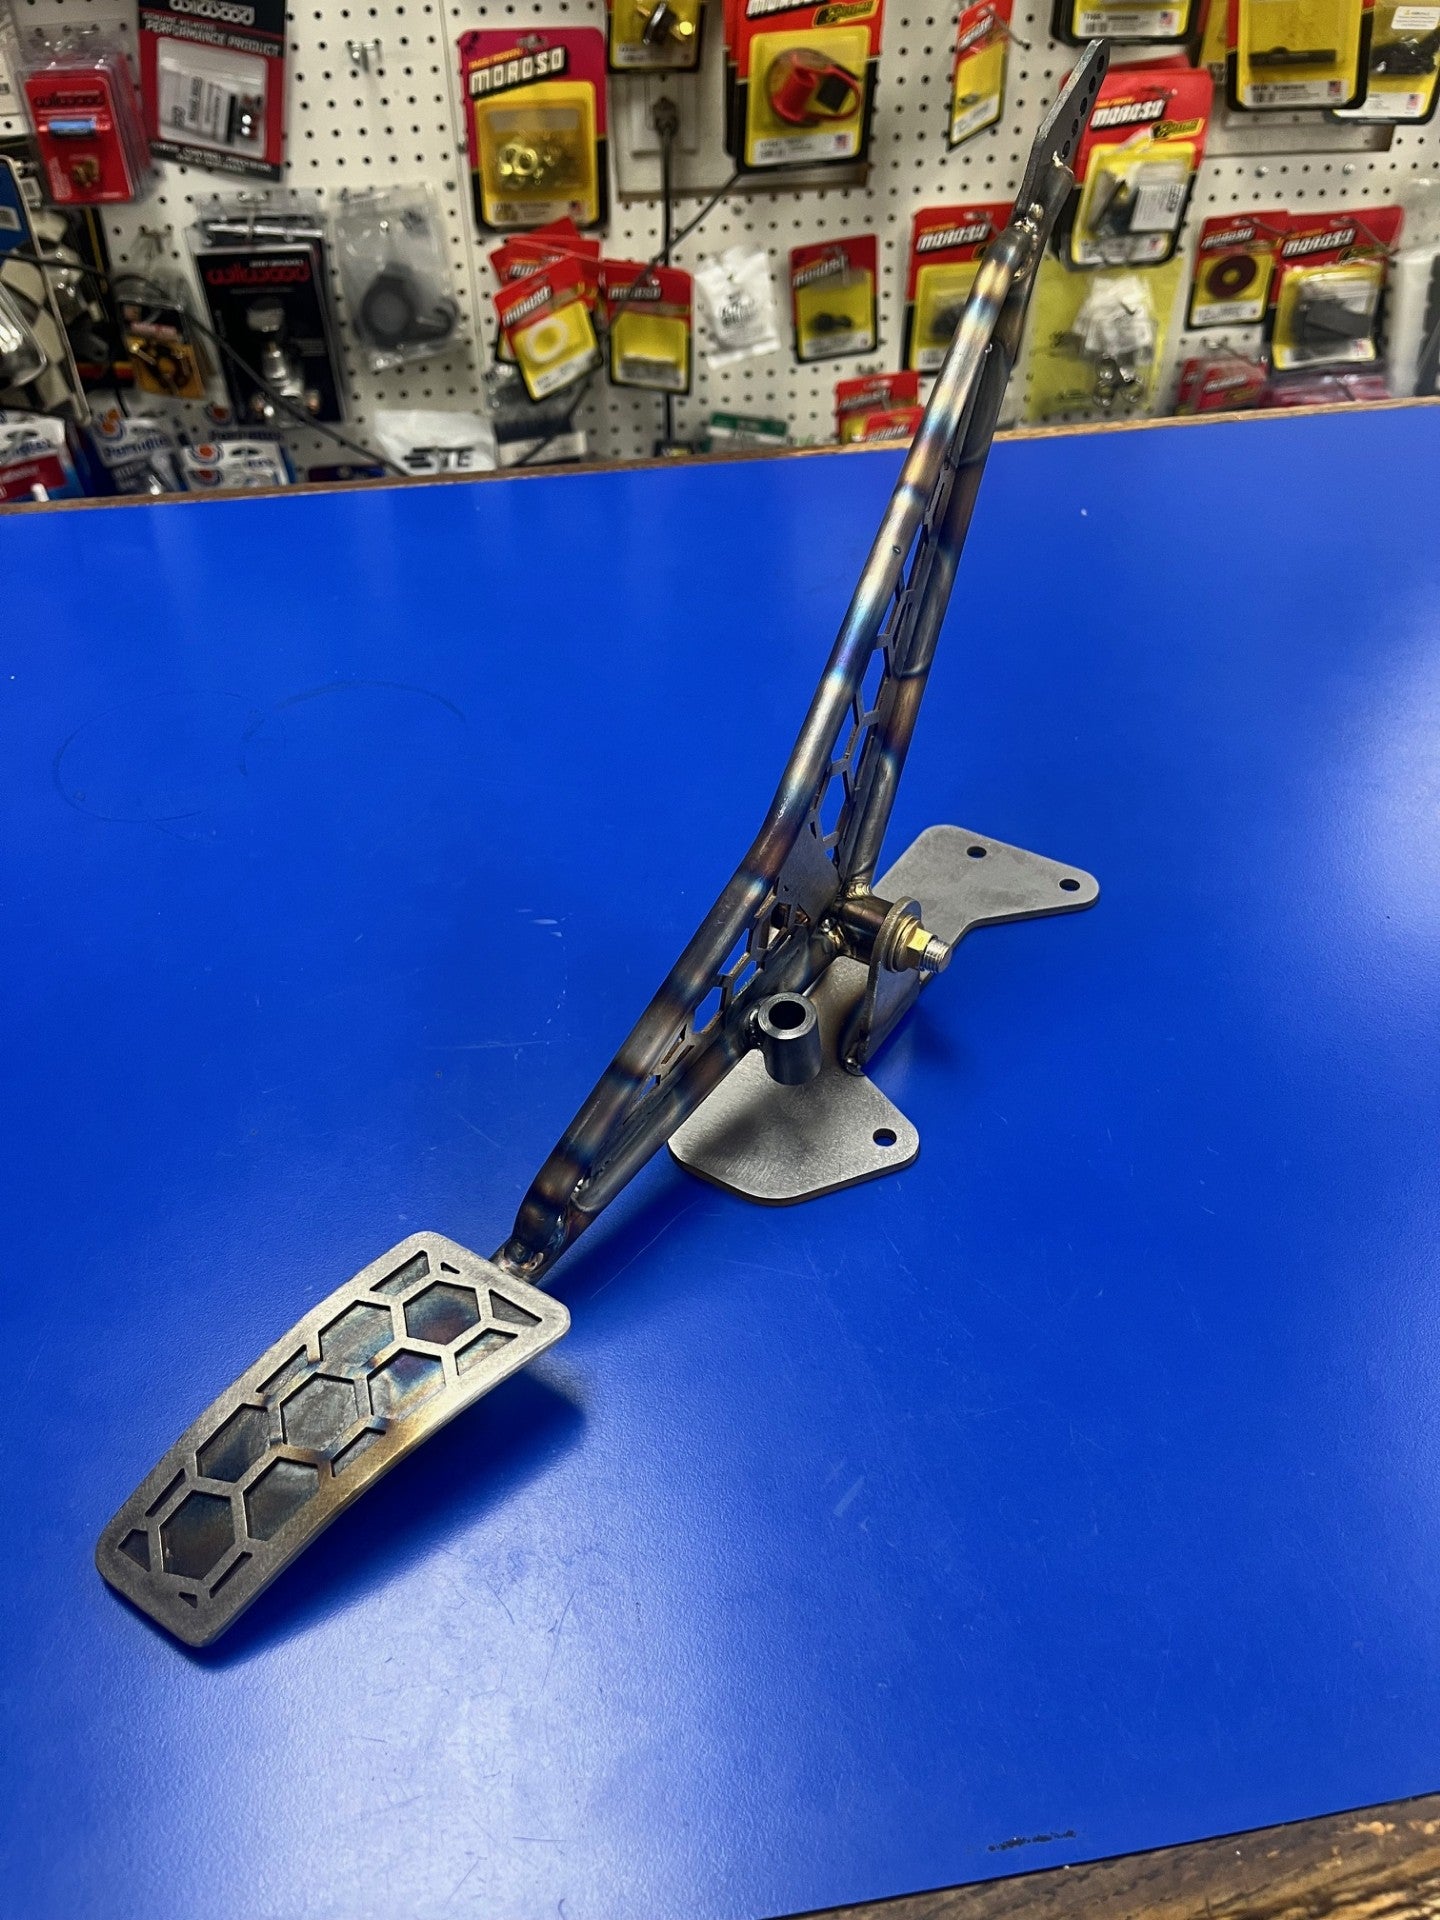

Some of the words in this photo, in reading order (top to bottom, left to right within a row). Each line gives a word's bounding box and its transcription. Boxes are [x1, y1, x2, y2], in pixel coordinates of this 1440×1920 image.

[144, 19, 228, 45] PERFORMANCE
[227, 35, 280, 57] PRODUCT
[469, 46, 565, 95] MOROSO
[1090, 99, 1166, 129] MOROSO
